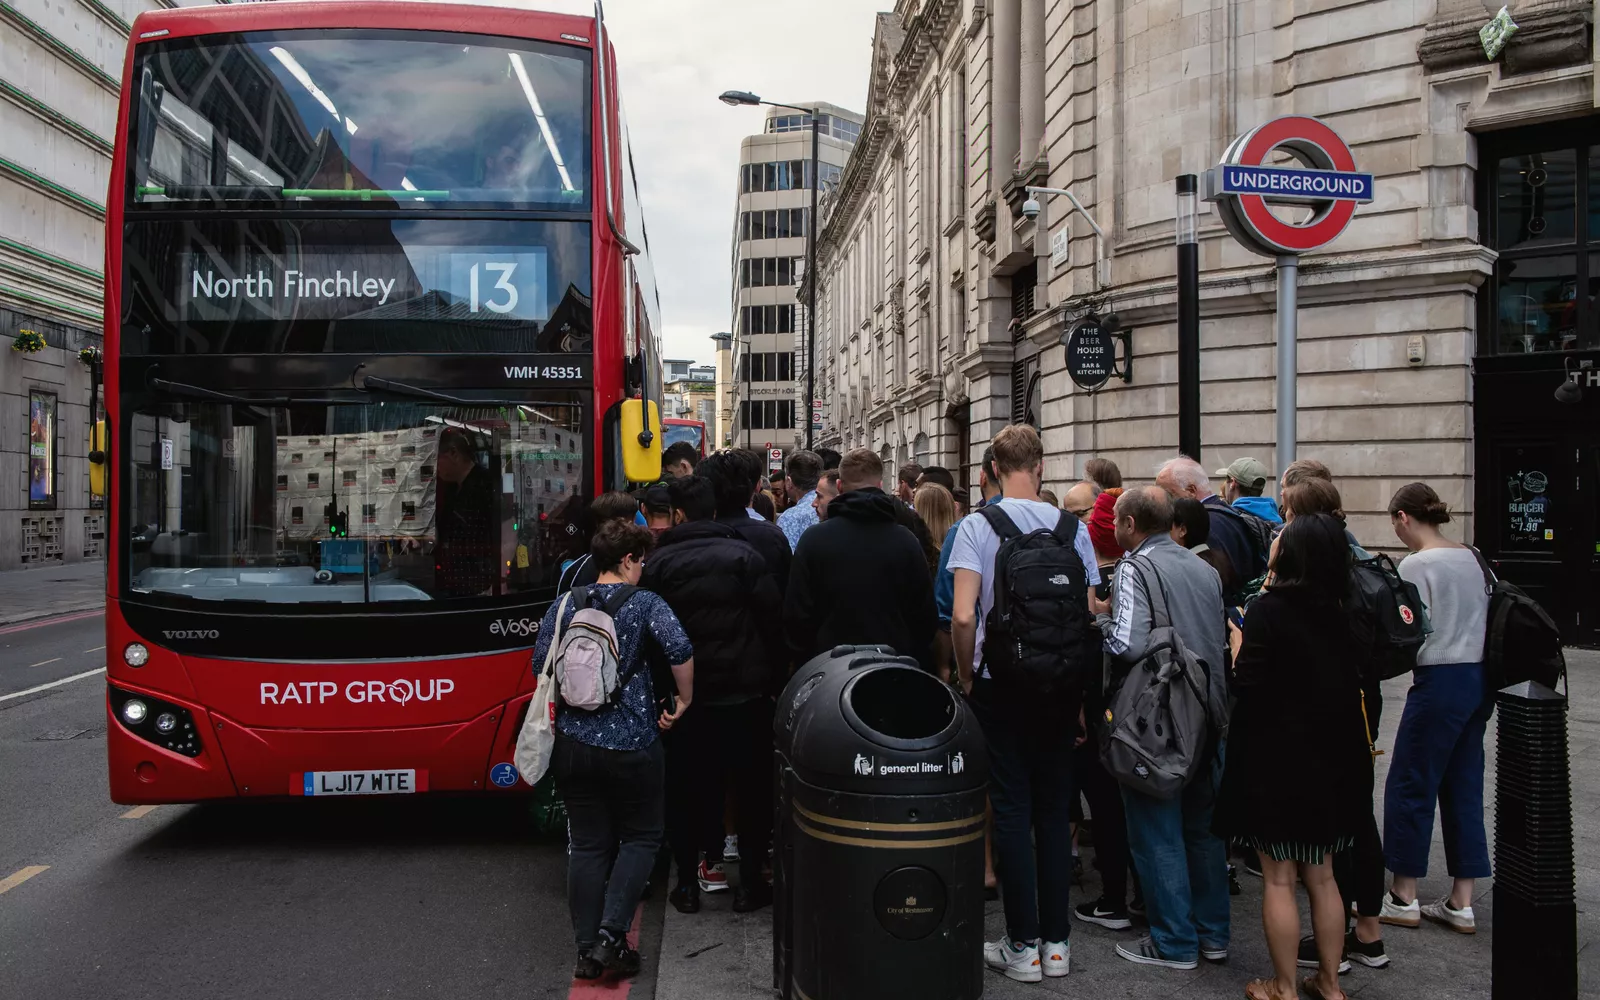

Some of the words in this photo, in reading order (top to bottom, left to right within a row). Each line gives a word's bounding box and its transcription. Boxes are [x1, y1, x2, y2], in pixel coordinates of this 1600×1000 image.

[1230, 171, 1364, 194] UNDERGROUND
[192, 270, 273, 298] North
[284, 270, 396, 305] Finchley
[469, 262, 519, 313] 13
[1080, 337, 1100, 345] BEER
[503, 366, 538, 379] VMH
[541, 366, 582, 379] 45351
[1570, 371, 1600, 387] TH
[1509, 503, 1544, 513] BURGER
[162, 629, 220, 639] VOLVO
[489, 617, 543, 637] eVoSet
[260, 681, 338, 704] RATP
[345, 678, 455, 707] GROUP
[880, 762, 920, 775] general
[921, 762, 943, 773] litter
[321, 774, 365, 793] LJ17
[371, 773, 409, 791] WTE
